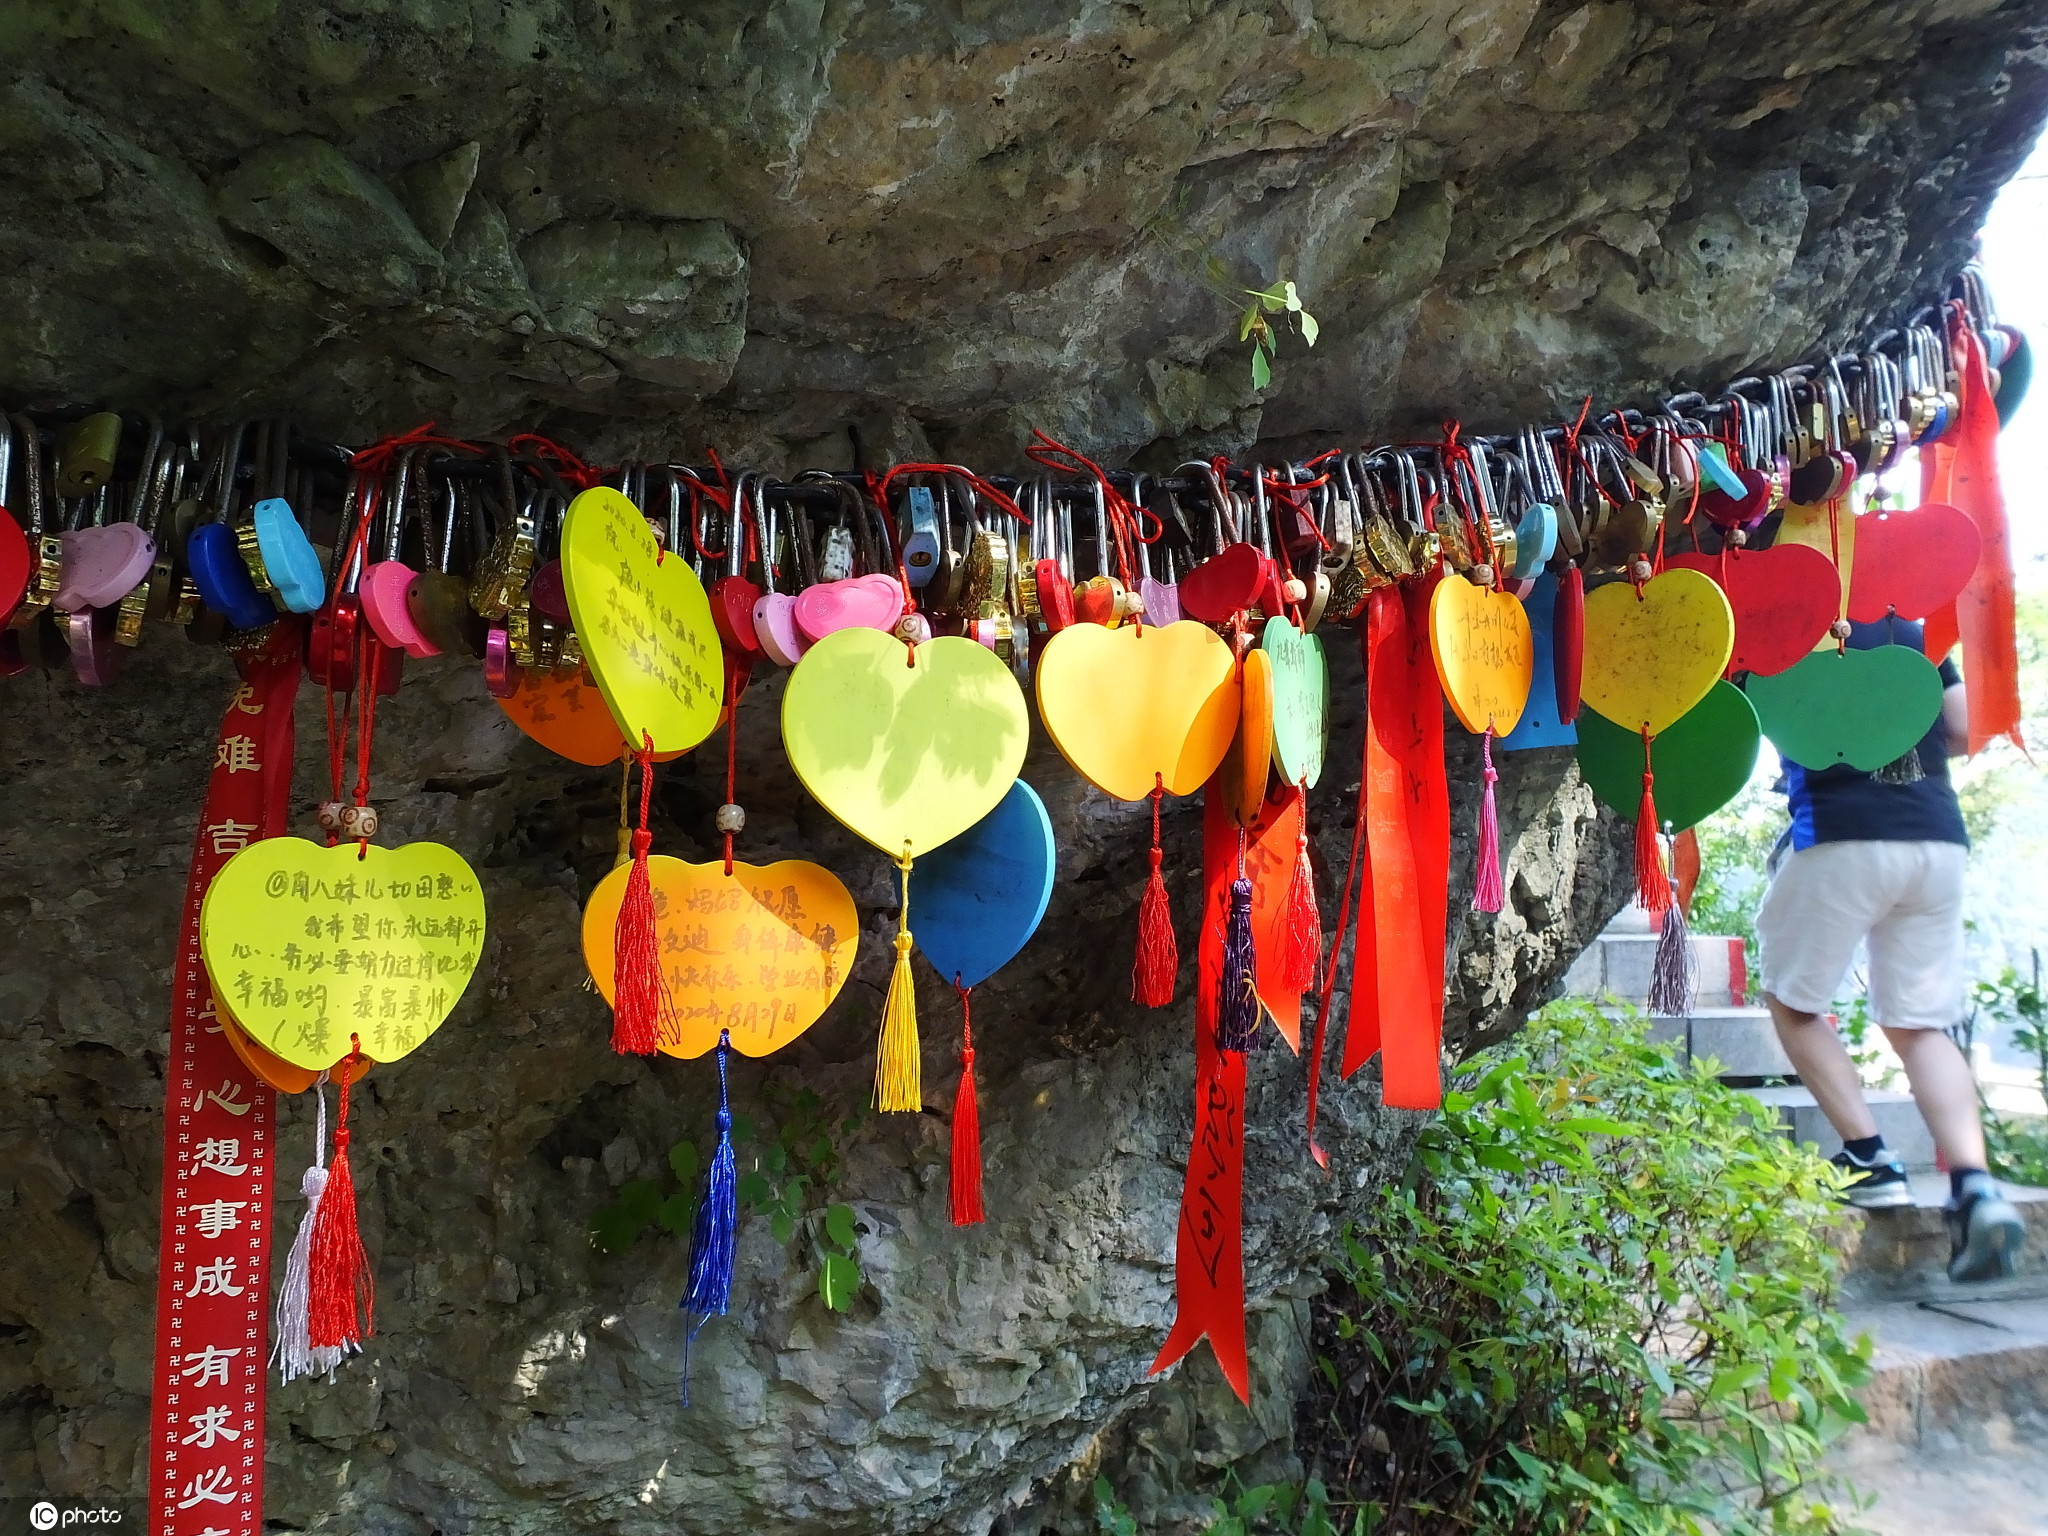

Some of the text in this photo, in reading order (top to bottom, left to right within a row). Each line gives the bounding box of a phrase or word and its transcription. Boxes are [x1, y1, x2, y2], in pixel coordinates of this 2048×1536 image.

[185, 1078, 252, 1298] 心想事成
[177, 1344, 242, 1536] 有求必
